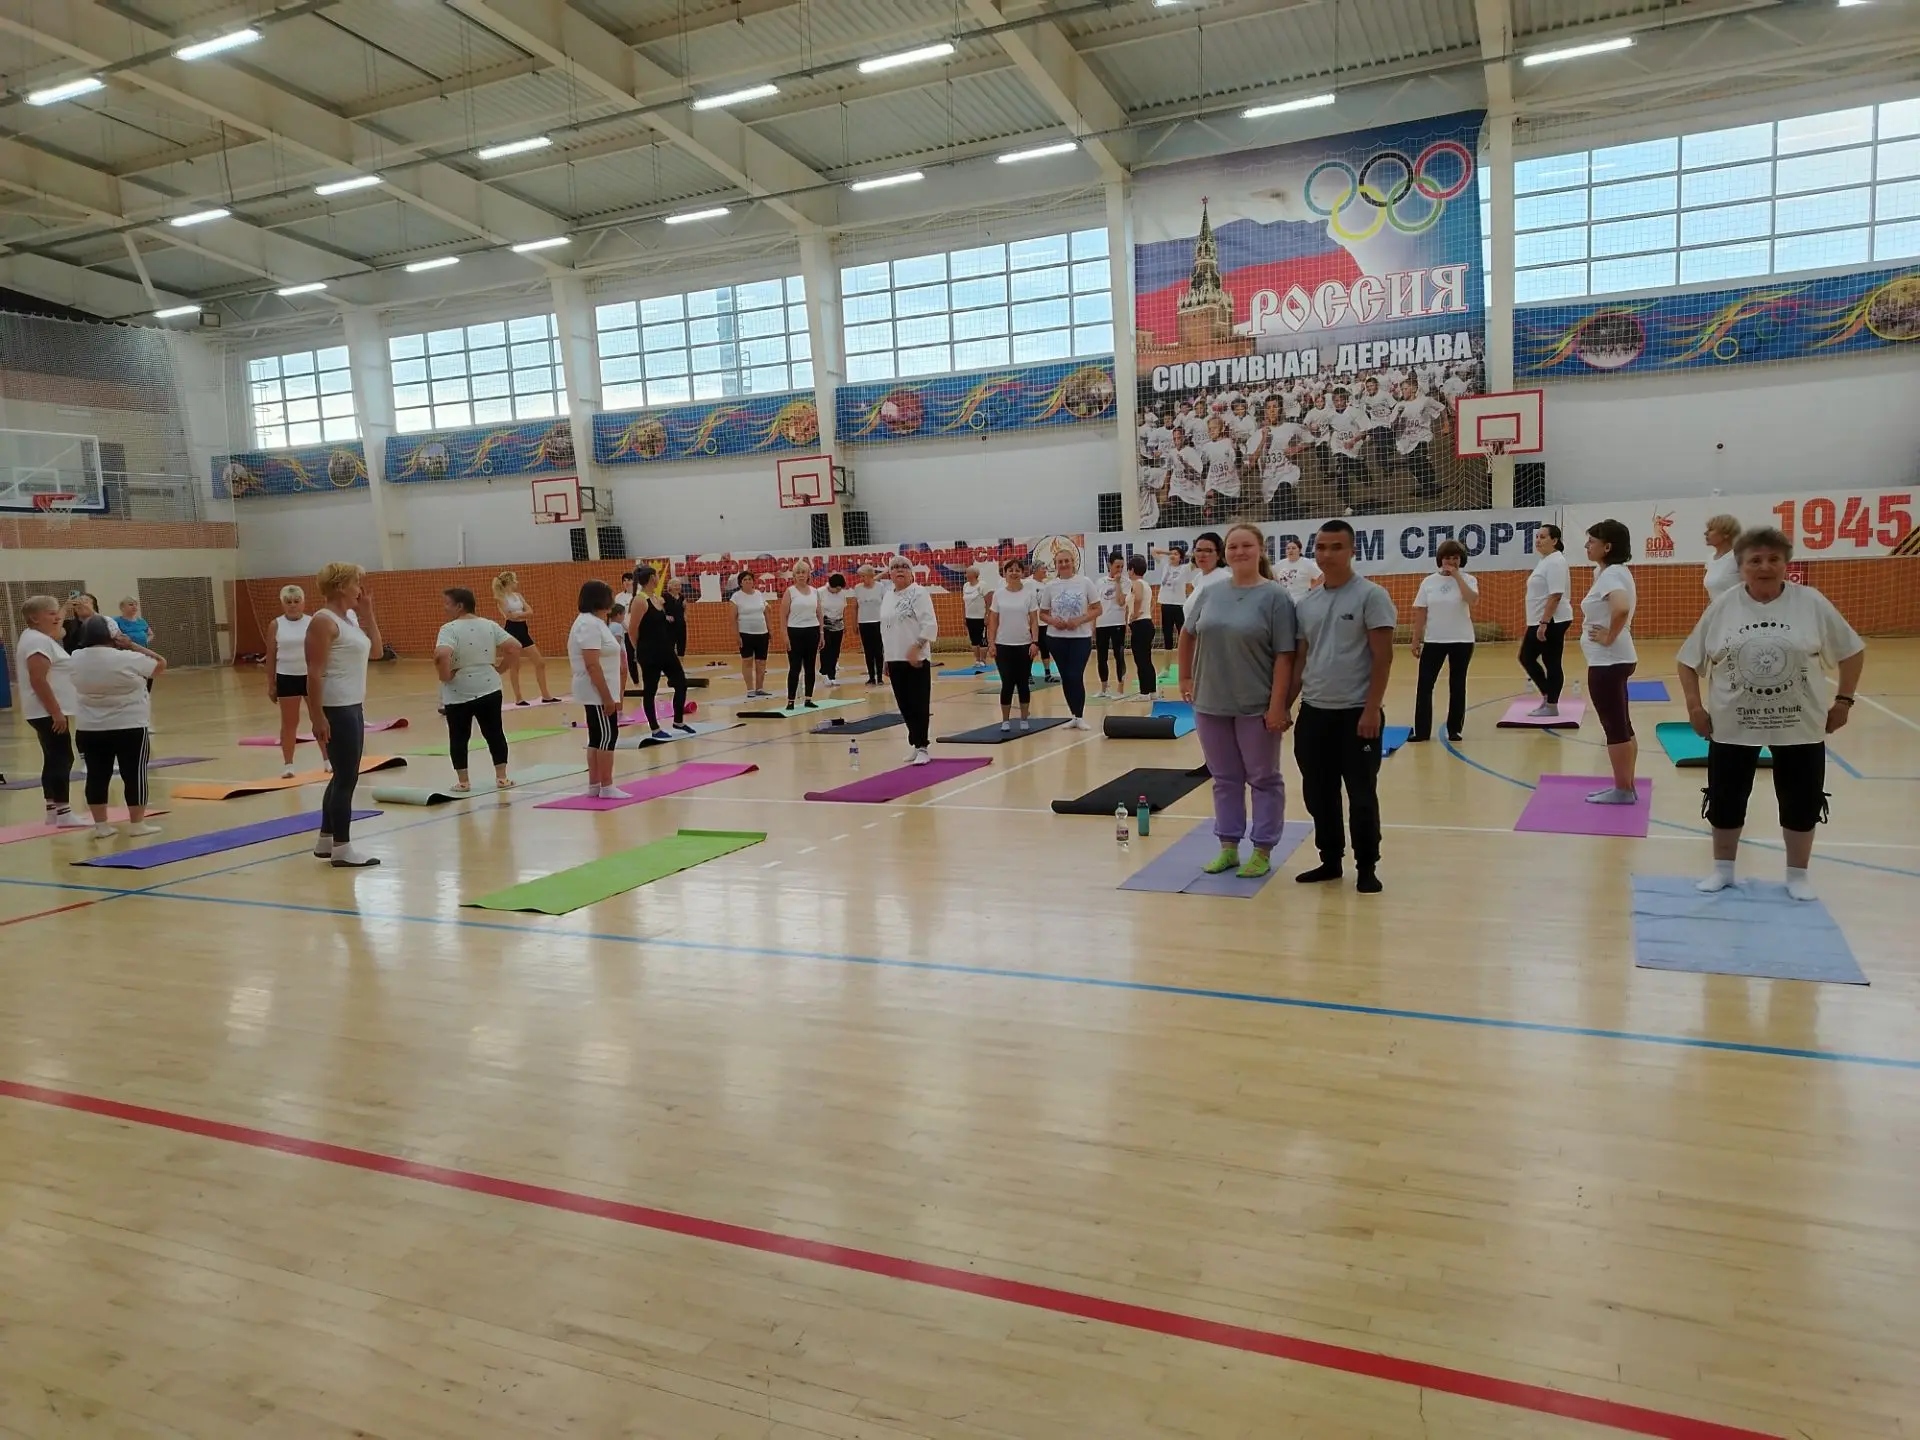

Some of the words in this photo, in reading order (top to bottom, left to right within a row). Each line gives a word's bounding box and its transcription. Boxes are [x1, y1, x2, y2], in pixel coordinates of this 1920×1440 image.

[1247, 263, 1469, 337] РОССИЯ
[1152, 347, 1319, 393] СПОРТИВНАЯ
[1335, 331, 1473, 376] ДЕРЖАВА
[1399, 520, 1544, 559] СПОРТ
[1772, 494, 1912, 550] 1945
